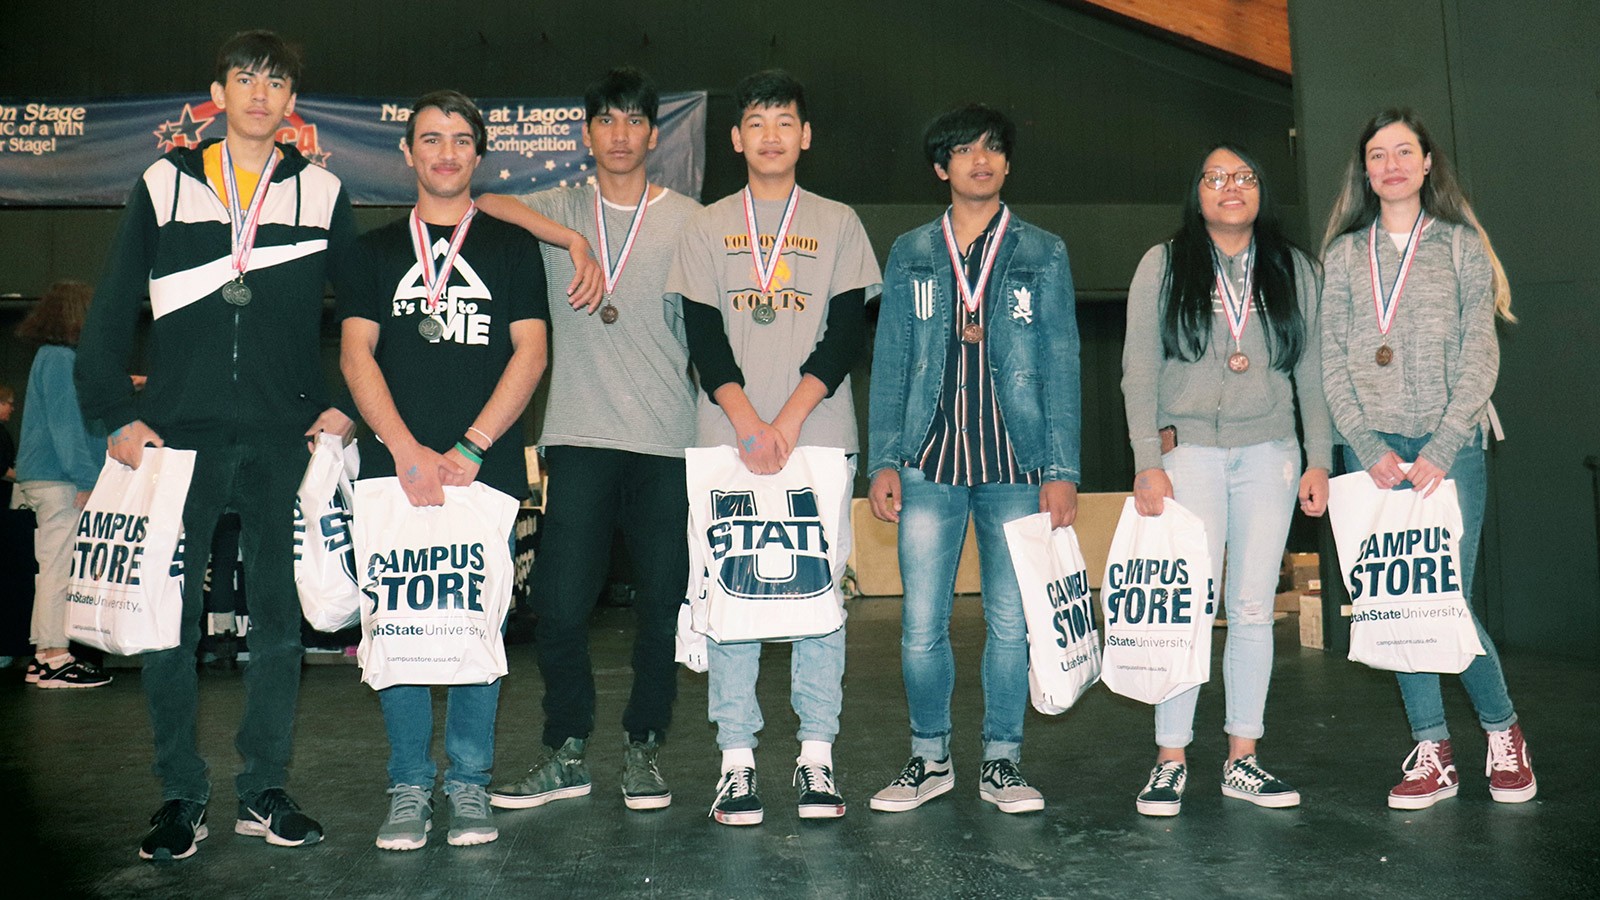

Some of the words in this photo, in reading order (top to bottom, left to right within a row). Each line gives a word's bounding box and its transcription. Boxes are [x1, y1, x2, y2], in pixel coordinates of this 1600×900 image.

[0, 106, 17, 121] n
[24, 103, 87, 123] Stage
[488, 106, 511, 122] at
[18, 121, 37, 136] of
[38, 124, 49, 136] a
[53, 121, 84, 136] WIN
[523, 122, 570, 136] Dance
[486, 137, 577, 155] Competition
[457, 300, 479, 315] to
[731, 292, 806, 313] COLTS
[429, 313, 492, 346] ME
[76, 510, 150, 543] AMPUS
[367, 542, 485, 581] CAMPUS
[1108, 557, 1190, 590] CMPUS
[1046, 569, 1088, 610] CAMPU
[1349, 554, 1460, 601] STORE
[360, 571, 486, 616] STORE
